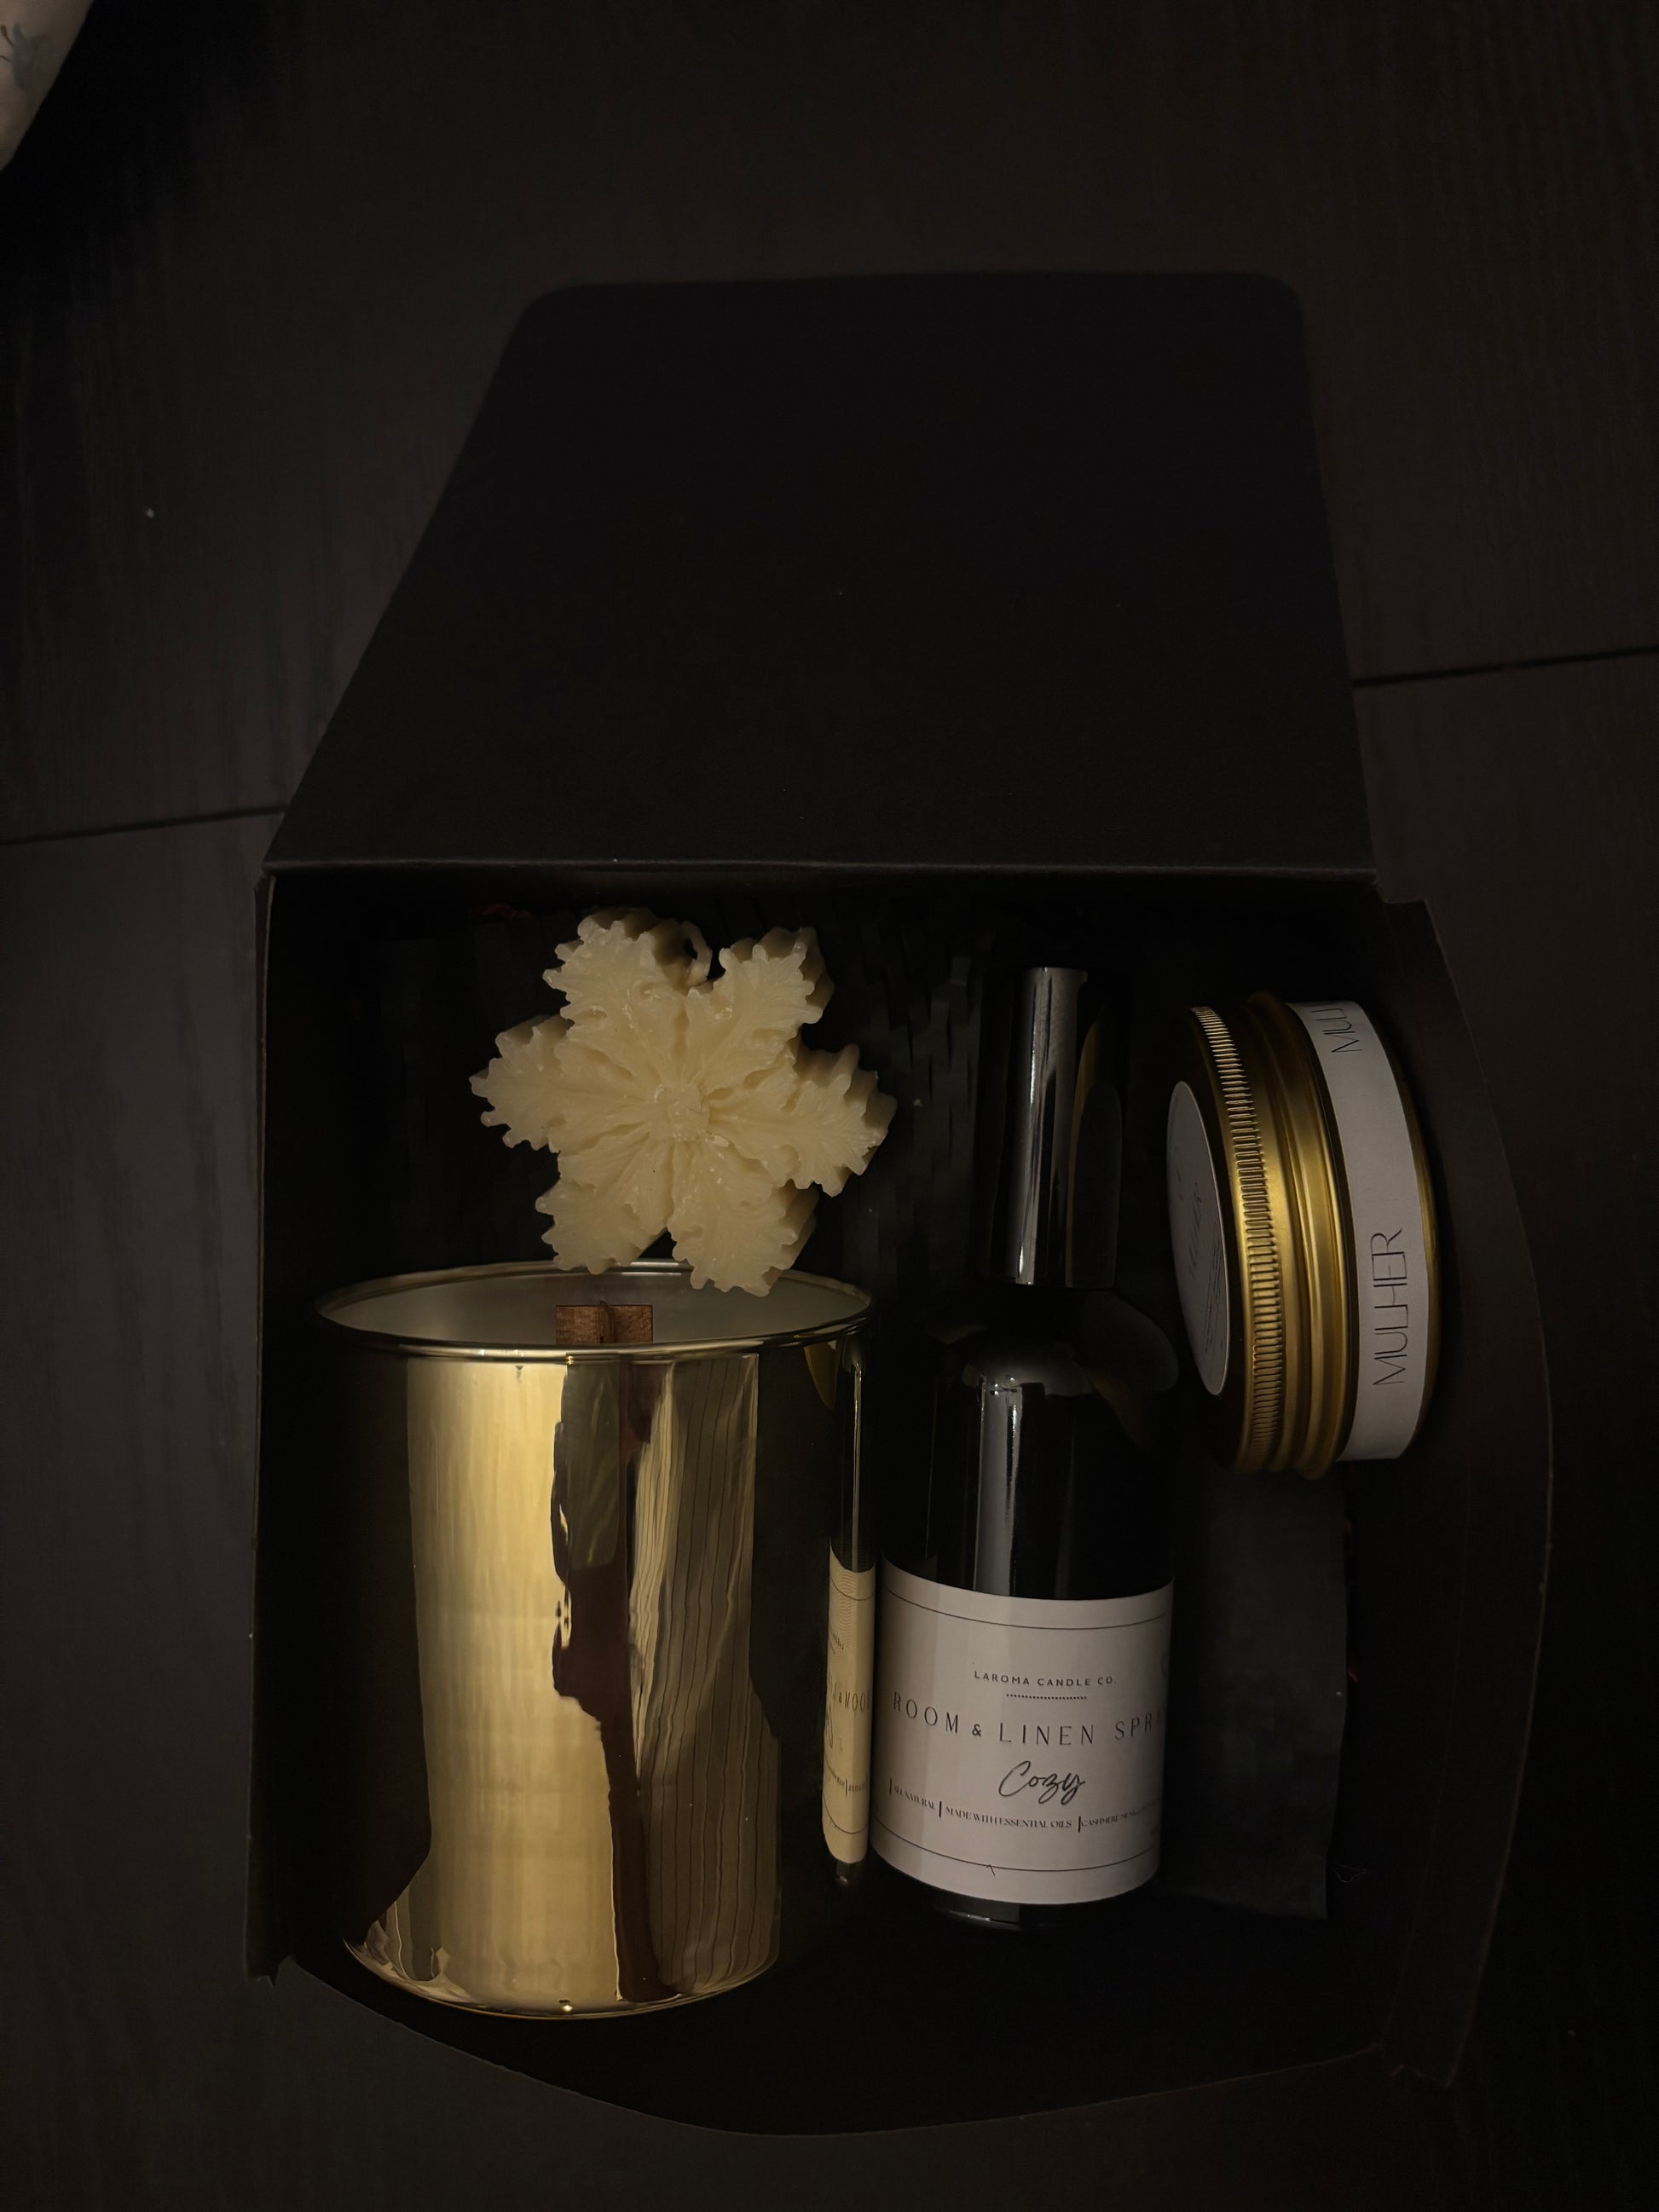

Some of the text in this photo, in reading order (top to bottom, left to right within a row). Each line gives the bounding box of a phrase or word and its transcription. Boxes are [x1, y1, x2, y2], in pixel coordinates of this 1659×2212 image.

[1370, 1227, 1408, 1386] MULHER
[974, 1670, 1030, 1685] LAROMA
[1037, 1677, 1091, 1687] CANDLE
[893, 1691, 959, 1734] ROOM
[972, 1724, 982, 1736] &
[999, 1722, 1095, 1746] LINEN
[998, 1760, 1085, 1805] Cozy
[946, 1806, 1072, 1828] MADE WITH ESSENTIAL OILS
